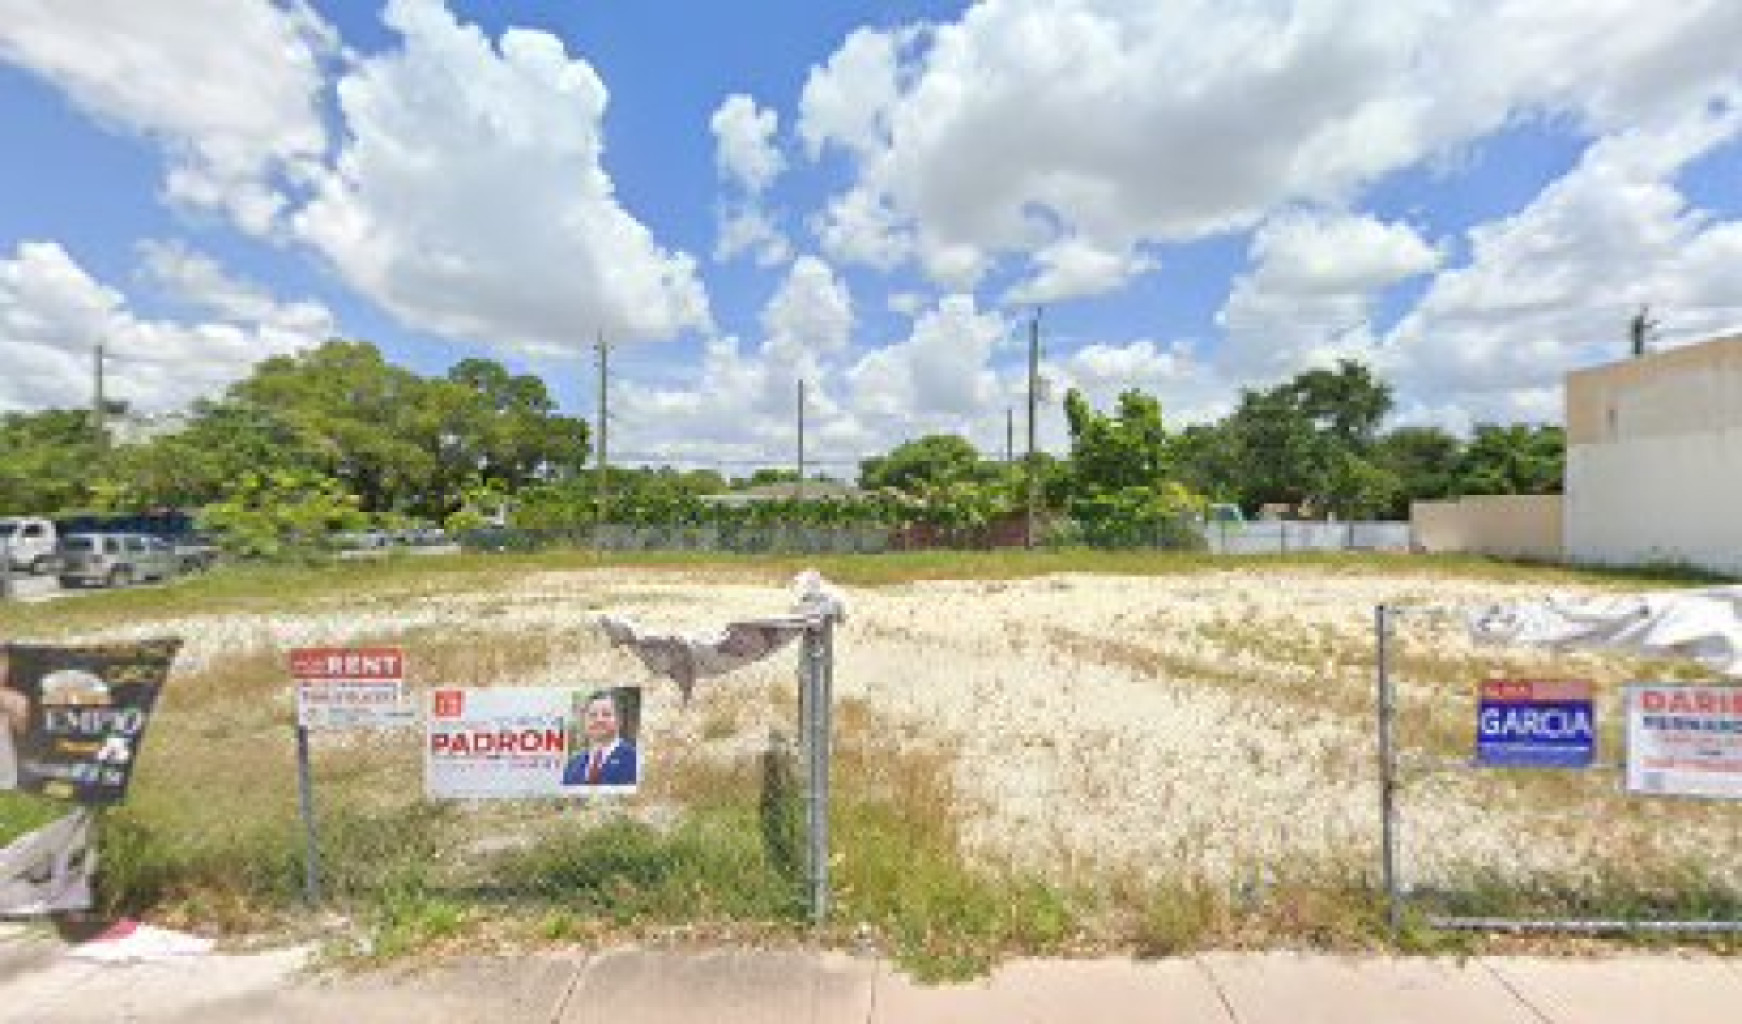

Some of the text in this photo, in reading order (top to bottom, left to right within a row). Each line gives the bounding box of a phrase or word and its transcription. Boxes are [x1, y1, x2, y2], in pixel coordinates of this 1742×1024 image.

[327, 655, 398, 675] RENT
[1481, 708, 1593, 737] GARCIA
[431, 729, 564, 755] PADRON
